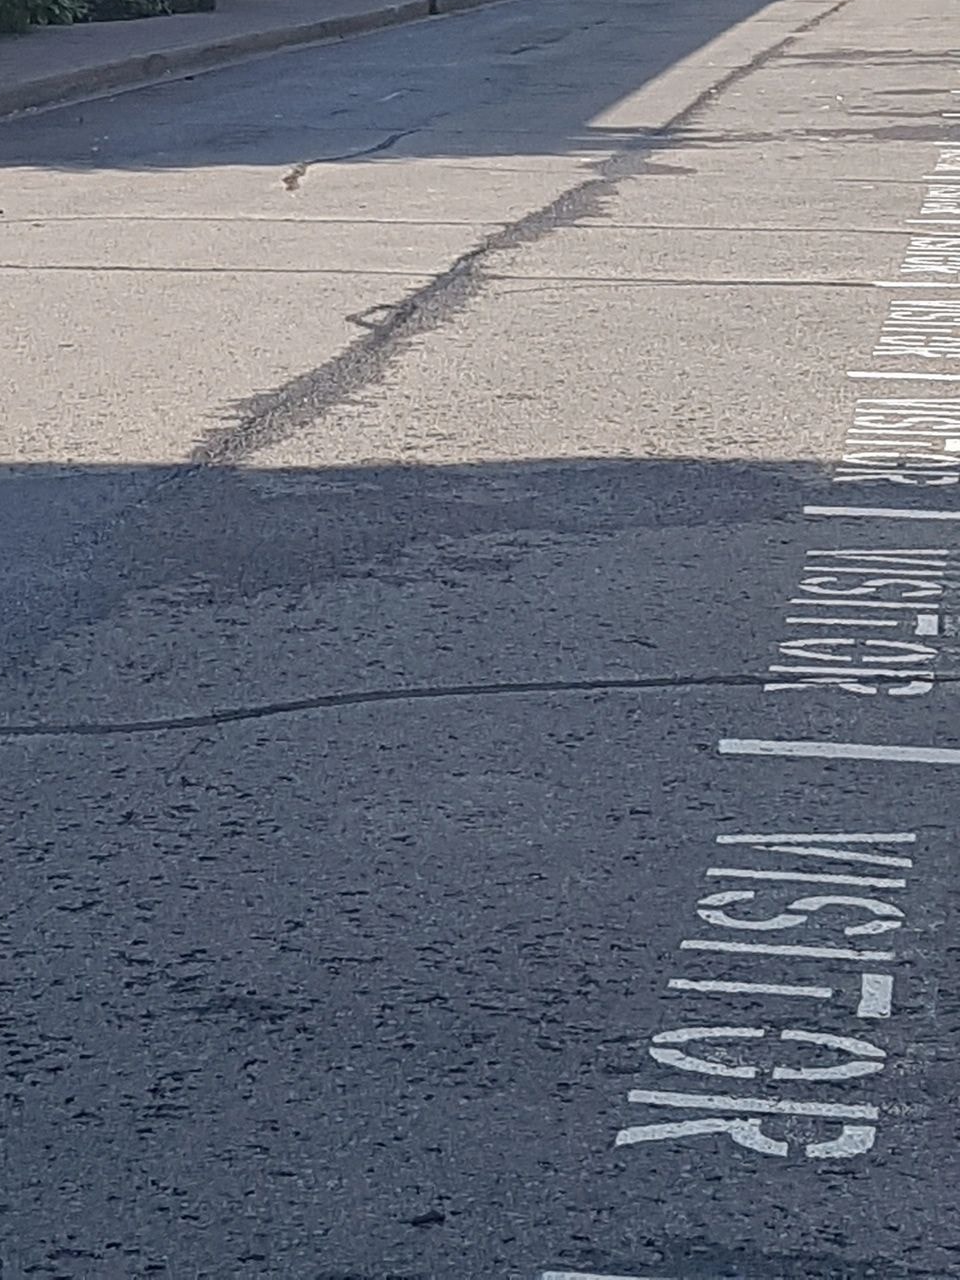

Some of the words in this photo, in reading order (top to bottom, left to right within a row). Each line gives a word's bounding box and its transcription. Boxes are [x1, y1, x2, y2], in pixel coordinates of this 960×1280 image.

[832, 398, 960, 485] VISITOR
[763, 548, 949, 696] VISITOR
[615, 832, 917, 1158] VISITOR
